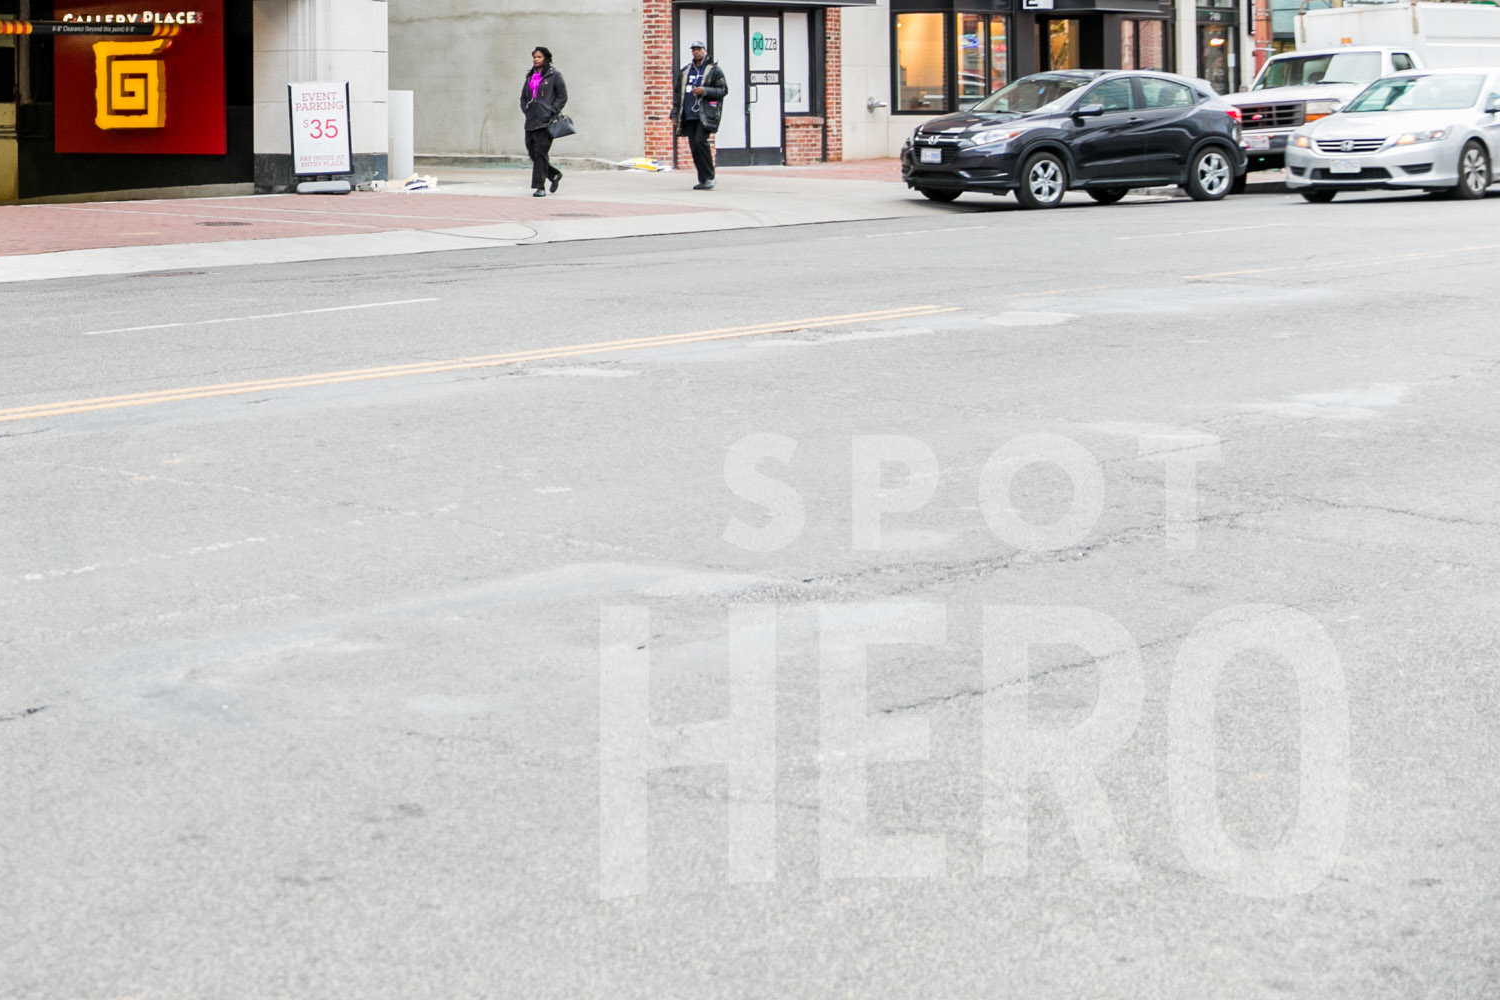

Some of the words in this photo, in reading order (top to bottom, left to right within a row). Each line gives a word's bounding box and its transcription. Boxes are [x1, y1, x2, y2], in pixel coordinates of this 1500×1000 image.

[142, 11, 199, 24] PLACE
[302, 92, 337, 101] EVENT
[295, 101, 344, 111] PARKING
[303, 119, 338, 139] $35
